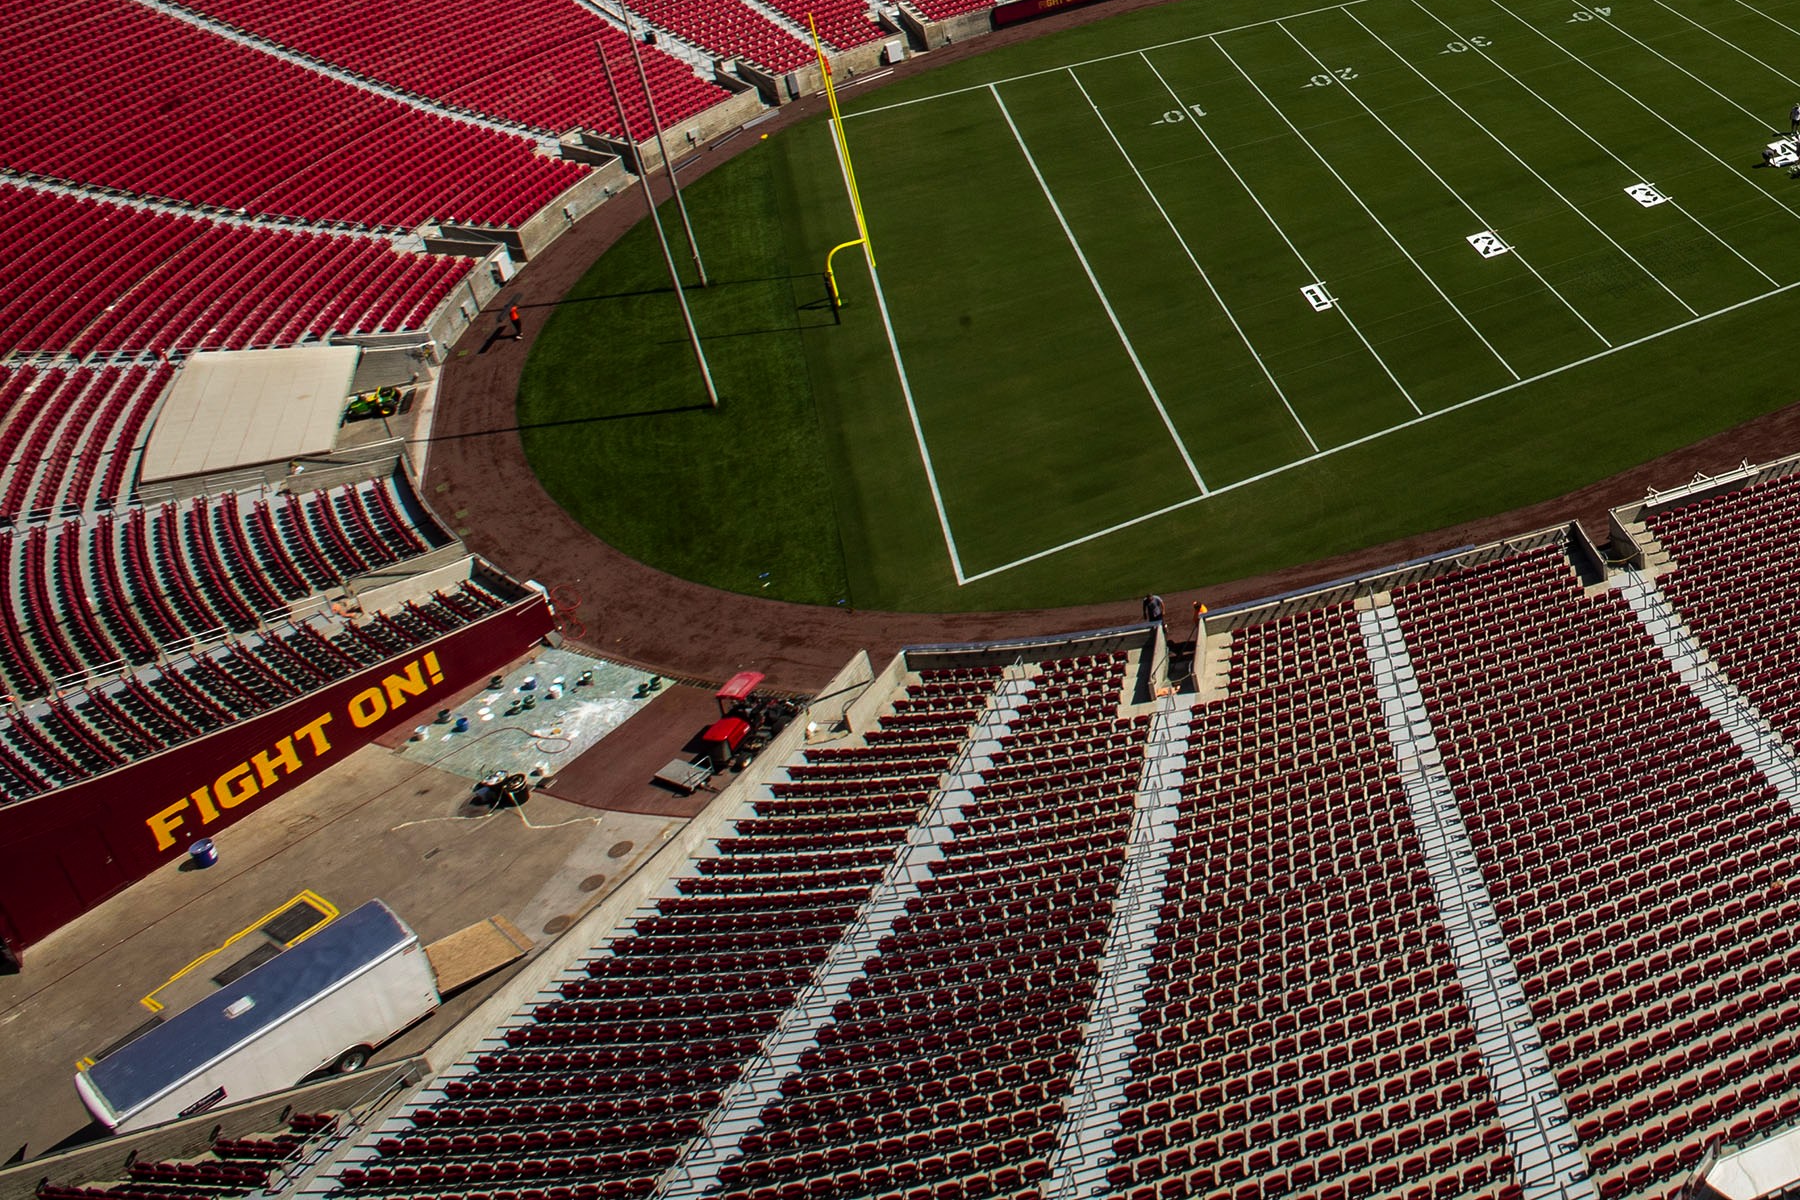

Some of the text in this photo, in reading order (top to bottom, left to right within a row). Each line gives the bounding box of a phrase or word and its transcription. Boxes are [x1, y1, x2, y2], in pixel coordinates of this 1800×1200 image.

[1572, 6, 1611, 21] 40
[1446, 36, 1493, 53] 30
[1310, 67, 1359, 86] 20
[1163, 104, 1207, 123] 10
[145, 650, 445, 852] FIGHT ON!
